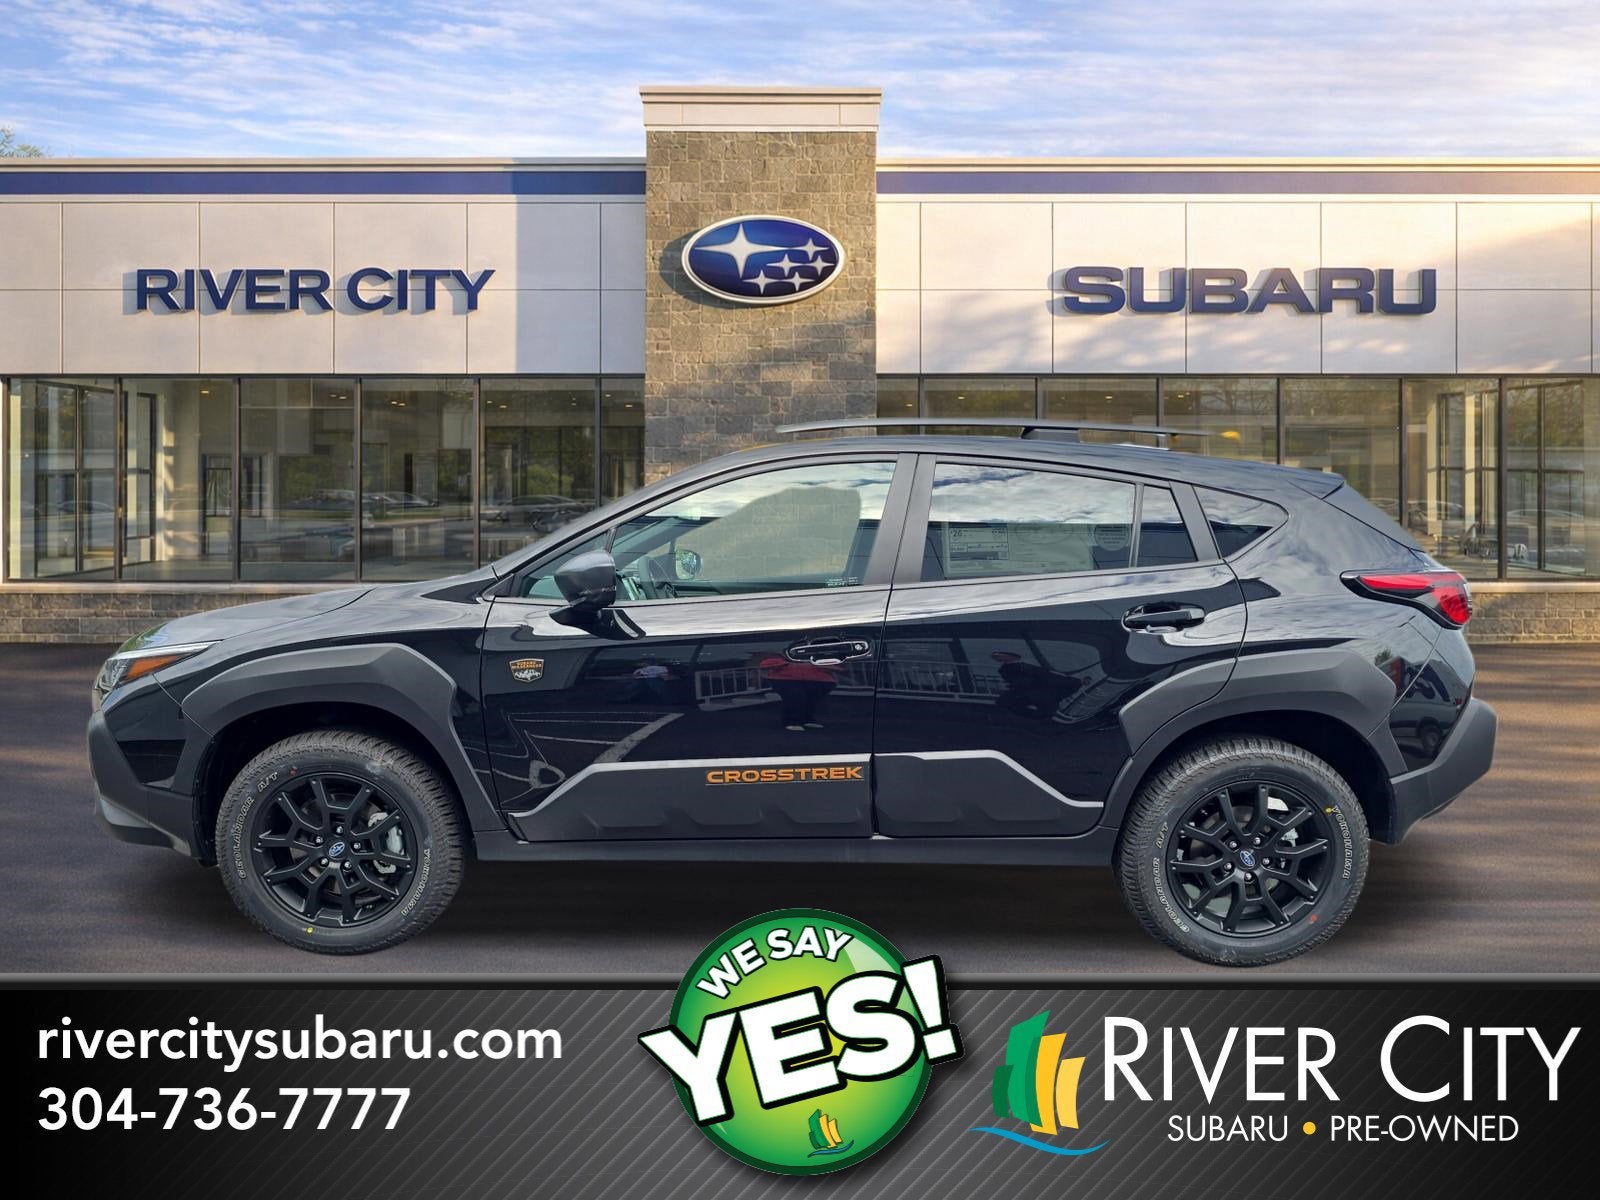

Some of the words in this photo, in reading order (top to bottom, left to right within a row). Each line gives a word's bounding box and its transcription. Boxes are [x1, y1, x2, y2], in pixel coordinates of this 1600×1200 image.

[135, 269, 334, 312] RIVER
[346, 267, 496, 312] CITY
[1063, 266, 1437, 314] SUBARU
[706, 766, 864, 784] CROSSTREK
[236, 796, 255, 880] GEOLANDAR
[256, 770, 278, 793] A/T
[1157, 822, 1169, 849] A/T
[1331, 805, 1354, 880] YOKOHAMA
[401, 848, 431, 917] YOKOHAMA
[1151, 857, 1191, 934] GEOLANDAR
